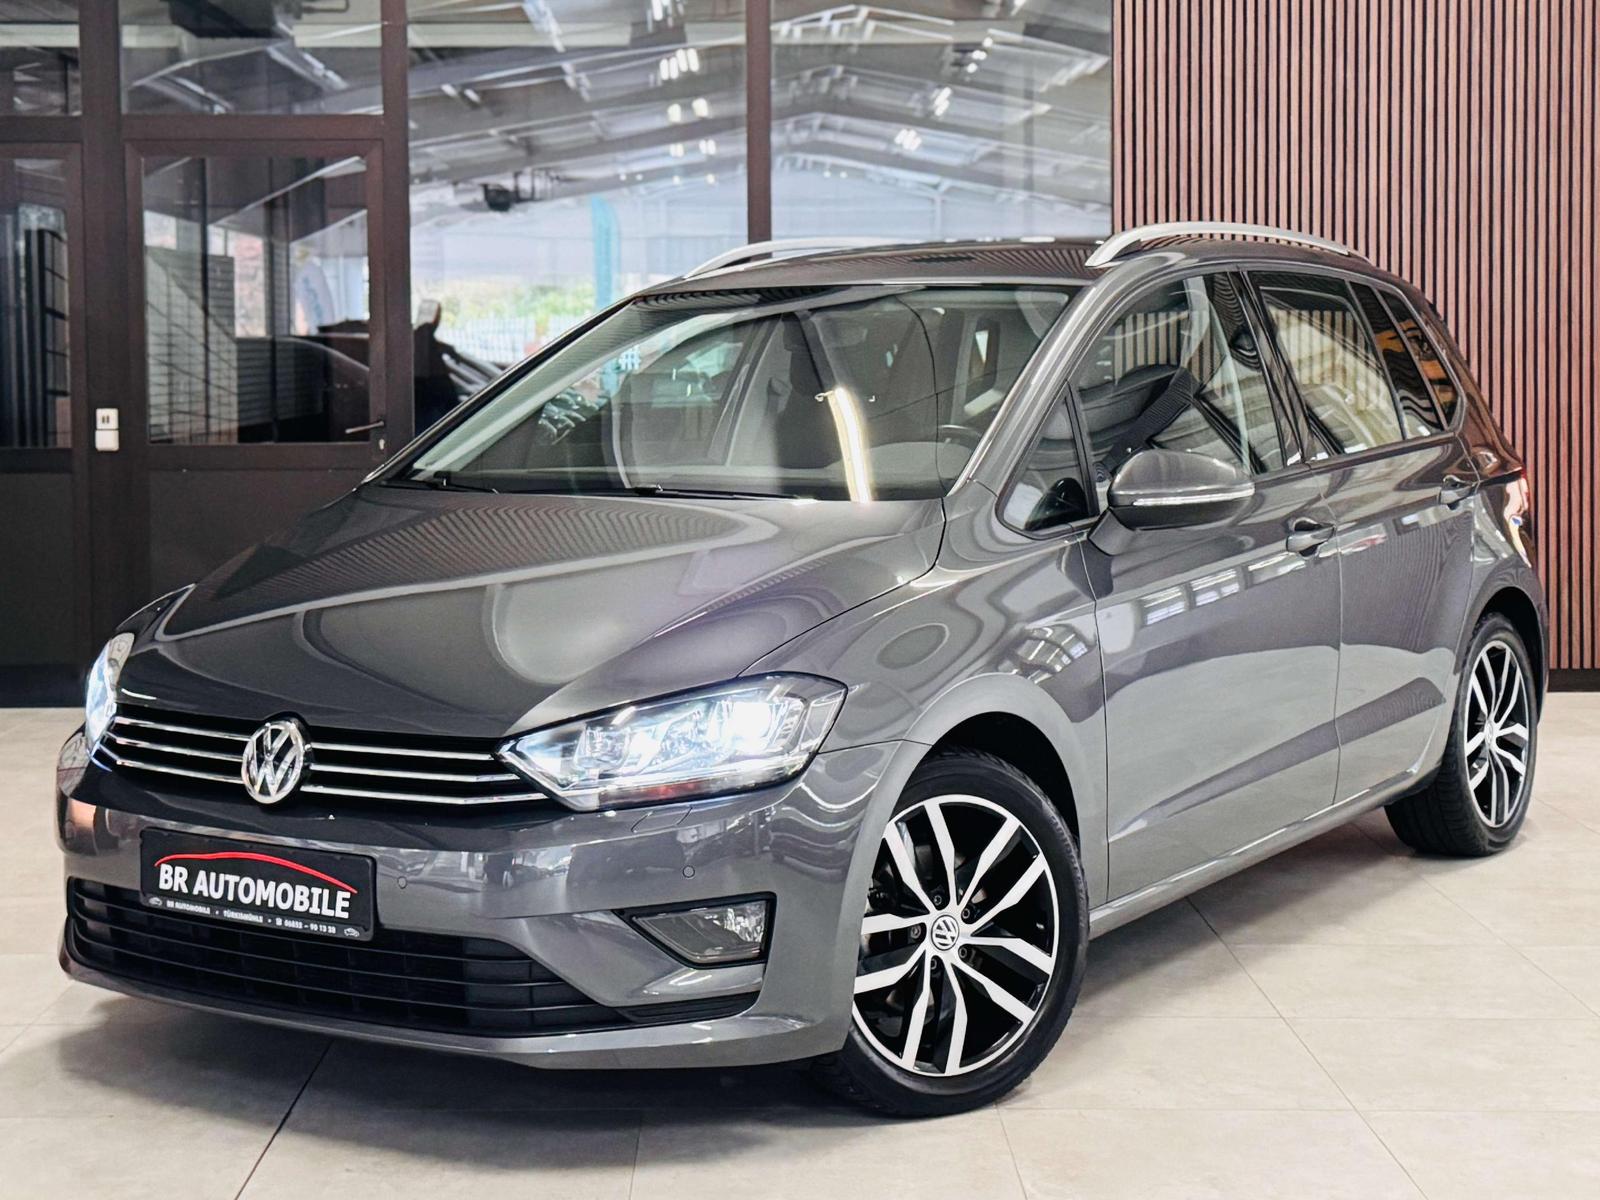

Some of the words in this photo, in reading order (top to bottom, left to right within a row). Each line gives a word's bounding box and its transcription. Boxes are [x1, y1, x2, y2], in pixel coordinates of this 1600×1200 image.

[241, 720, 304, 804] VW
[158, 863, 189, 894] BR
[192, 869, 351, 919] AUTOMOBILE
